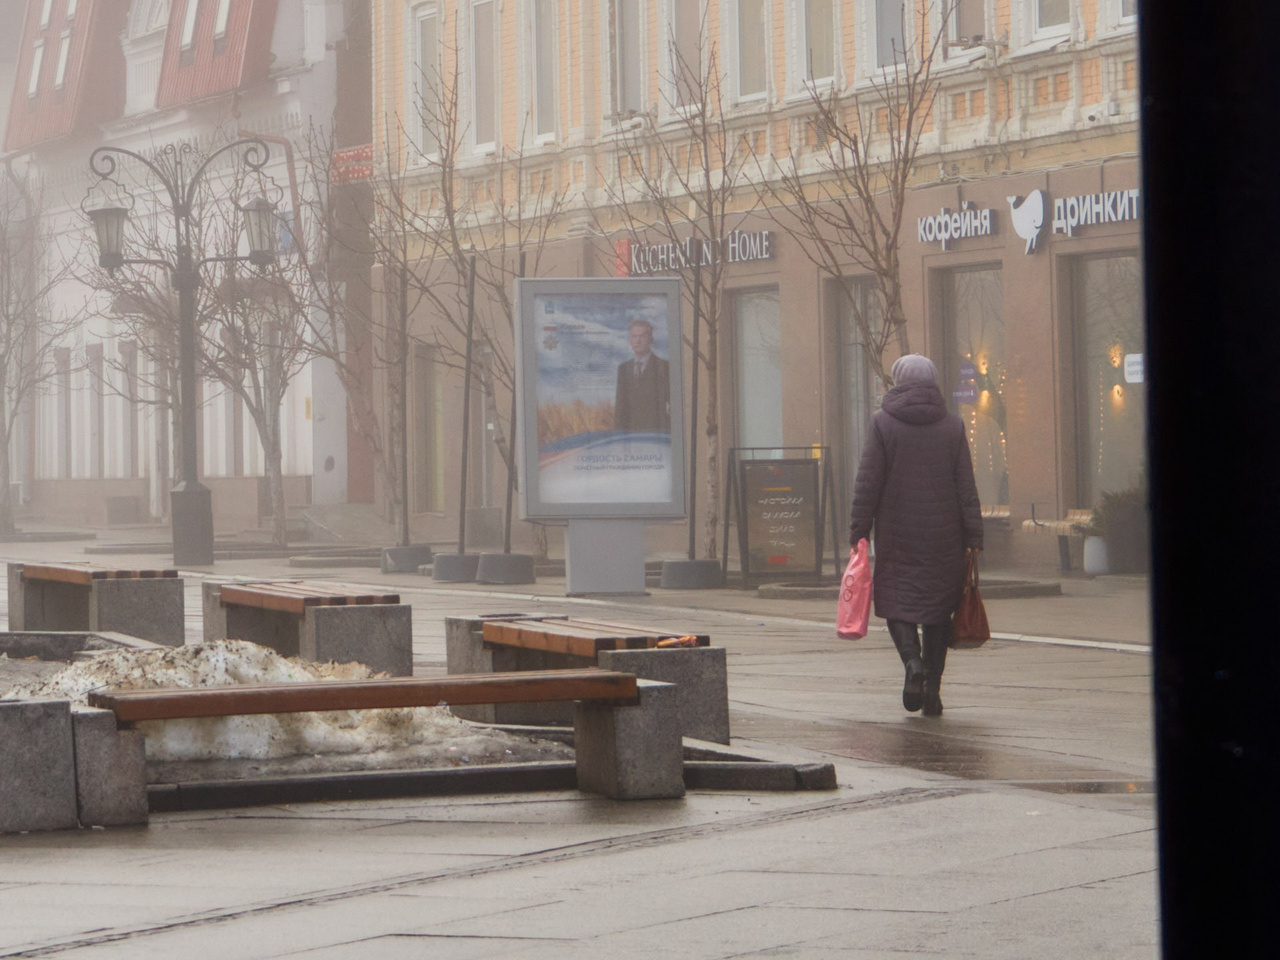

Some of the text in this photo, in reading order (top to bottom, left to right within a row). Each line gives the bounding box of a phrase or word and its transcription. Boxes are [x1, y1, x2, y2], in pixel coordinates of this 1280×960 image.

[917, 189, 1141, 251] кофейня дринкит
[728, 229, 770, 263] HOME
